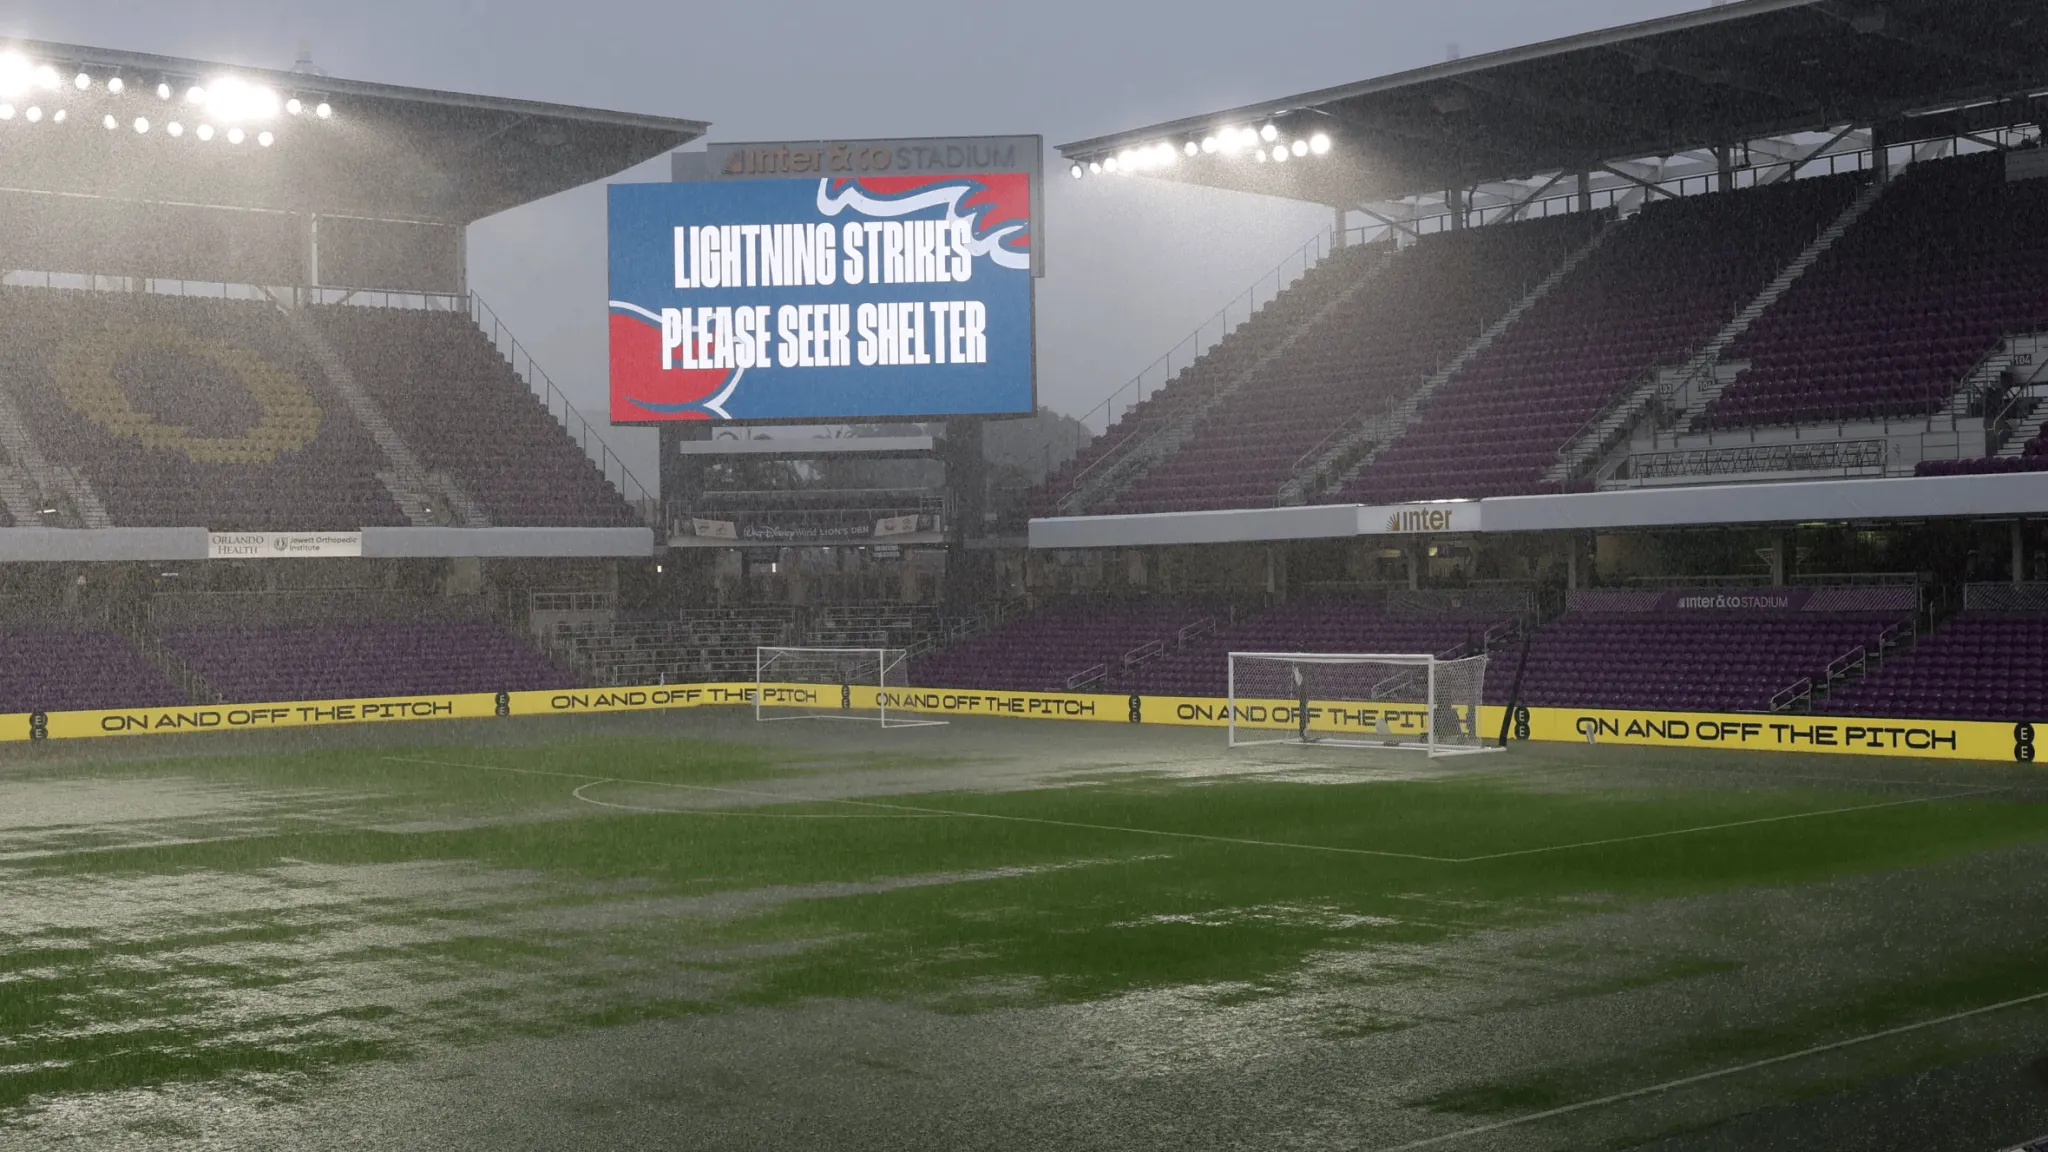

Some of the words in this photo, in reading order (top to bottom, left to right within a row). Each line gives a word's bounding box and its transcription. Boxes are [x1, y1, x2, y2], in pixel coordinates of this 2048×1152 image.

[896, 144, 1016, 170] STADIUM
[673, 222, 837, 289] LIGHTNING
[842, 219, 972, 284] STRIKES
[661, 304, 771, 371] PLEASE
[778, 303, 851, 367] SEEK
[857, 300, 987, 367] SHELTER
[2014, 355, 2031, 365] 104
[851, 525, 869, 535] DEN
[1402, 506, 1453, 532] inter
[212, 535, 264, 545] ORLANDO
[217, 545, 258, 555] HEALTH
[289, 544, 321, 552] Institute
[315, 535, 358, 546] Orthopedic
[1741, 597, 1789, 608] STADIUM
[551, 694, 589, 710] ON
[593, 692, 647, 707] AND
[651, 689, 702, 704] OFF
[707, 688, 757, 702] THE
[763, 688, 817, 703] PITCH
[876, 692, 900, 708] ON
[903, 692, 940, 710] AND
[942, 694, 982, 710] OFF
[981, 696, 1025, 713] THE
[1029, 698, 1095, 716] PITCH
[101, 714, 148, 732] ON
[155, 709, 221, 730] AND
[227, 707, 291, 725] OFF
[297, 704, 356, 722] THE
[361, 700, 453, 719] PITCH
[1177, 703, 1213, 721] ON
[1217, 704, 1268, 723] AND
[1272, 706, 1323, 724] OFF
[1328, 707, 1379, 727] THE
[1576, 716, 1619, 737] ON
[1625, 718, 1689, 740] AND
[1696, 720, 1763, 742] OFF
[1769, 722, 1838, 746] THE
[1846, 725, 1957, 751] PITCH
